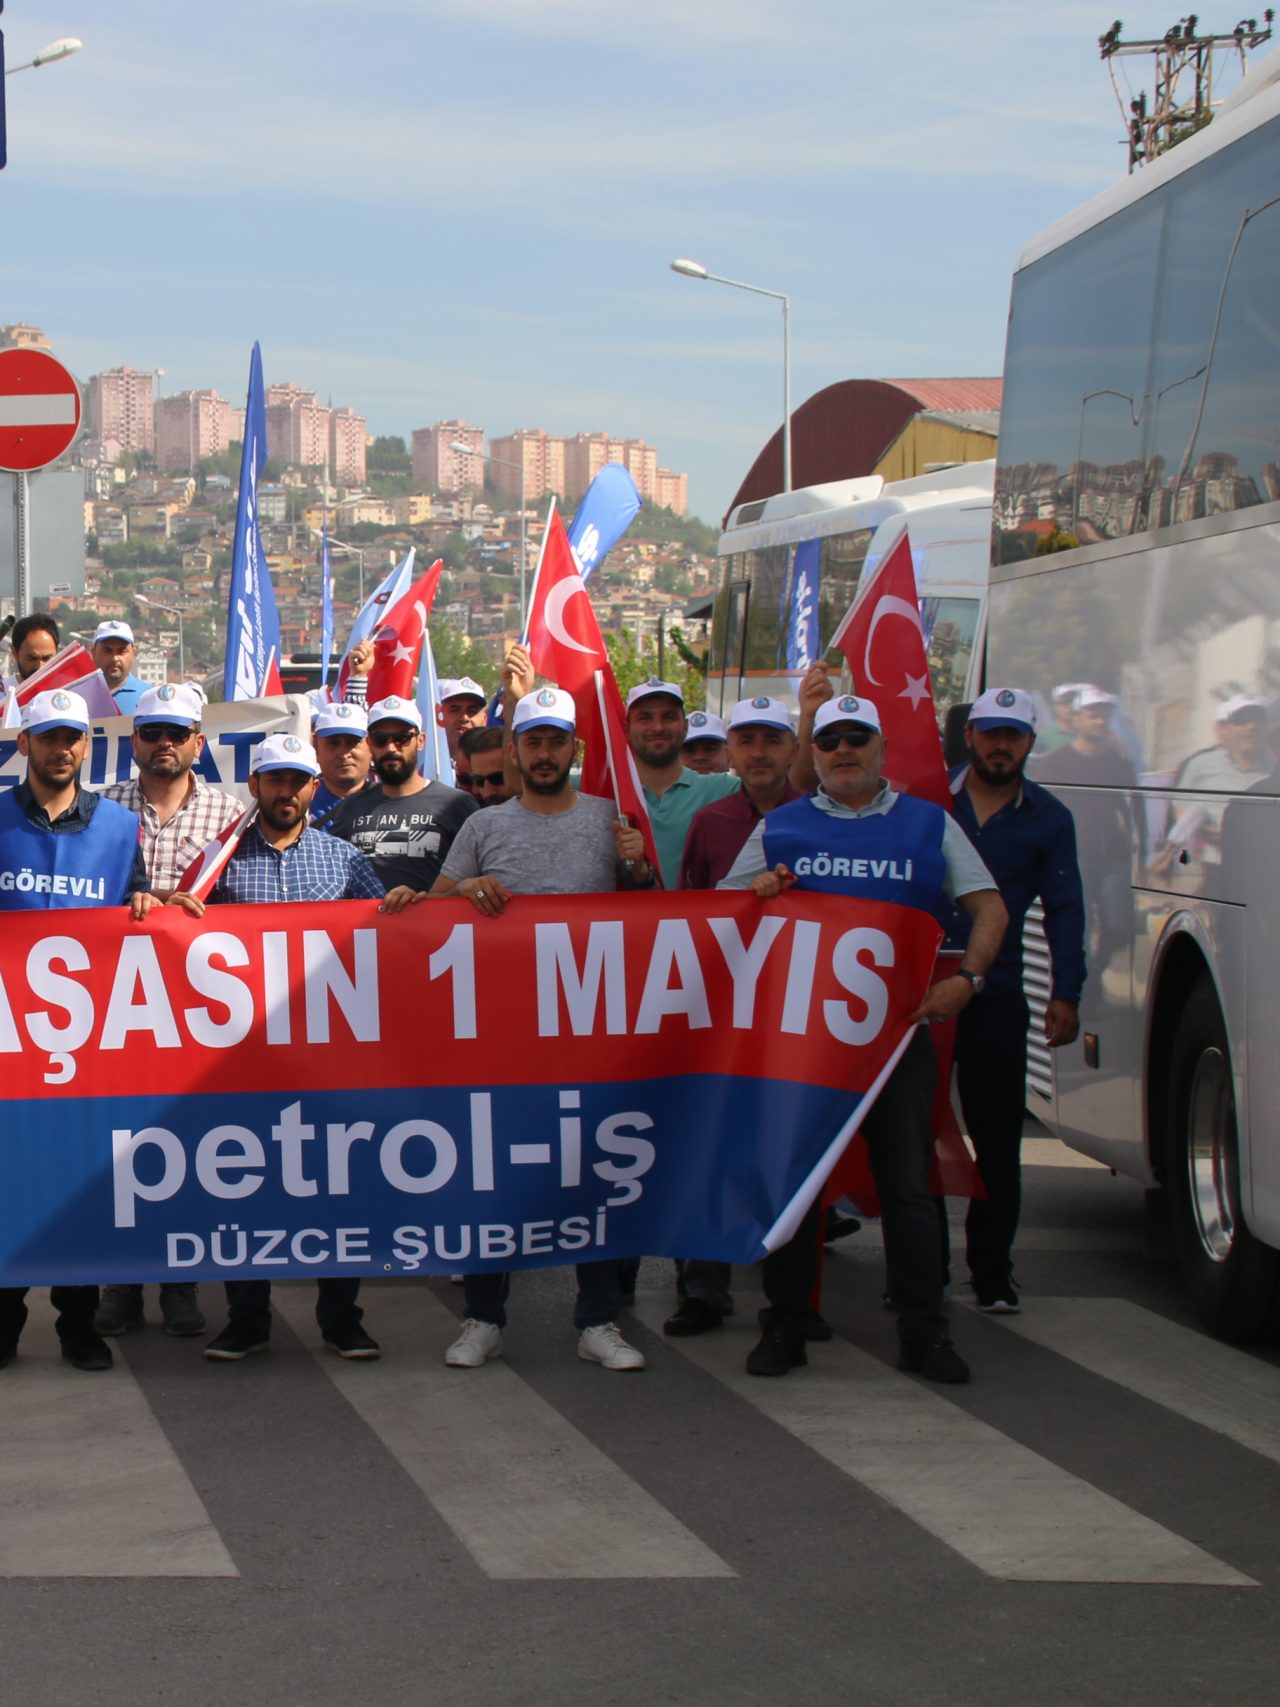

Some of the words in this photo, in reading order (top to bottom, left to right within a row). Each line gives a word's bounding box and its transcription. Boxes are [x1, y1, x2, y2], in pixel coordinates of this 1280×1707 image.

[0, 868, 105, 900] GÖREVLİ
[794, 852, 912, 881] GÖREVLİ
[429, 923, 477, 1039] 1
[534, 915, 895, 1046] MAYIS
[112, 1089, 656, 1228] petrol-iş
[166, 1223, 371, 1268] DÜZCE
[392, 1206, 606, 1270] ŞUBESİ
